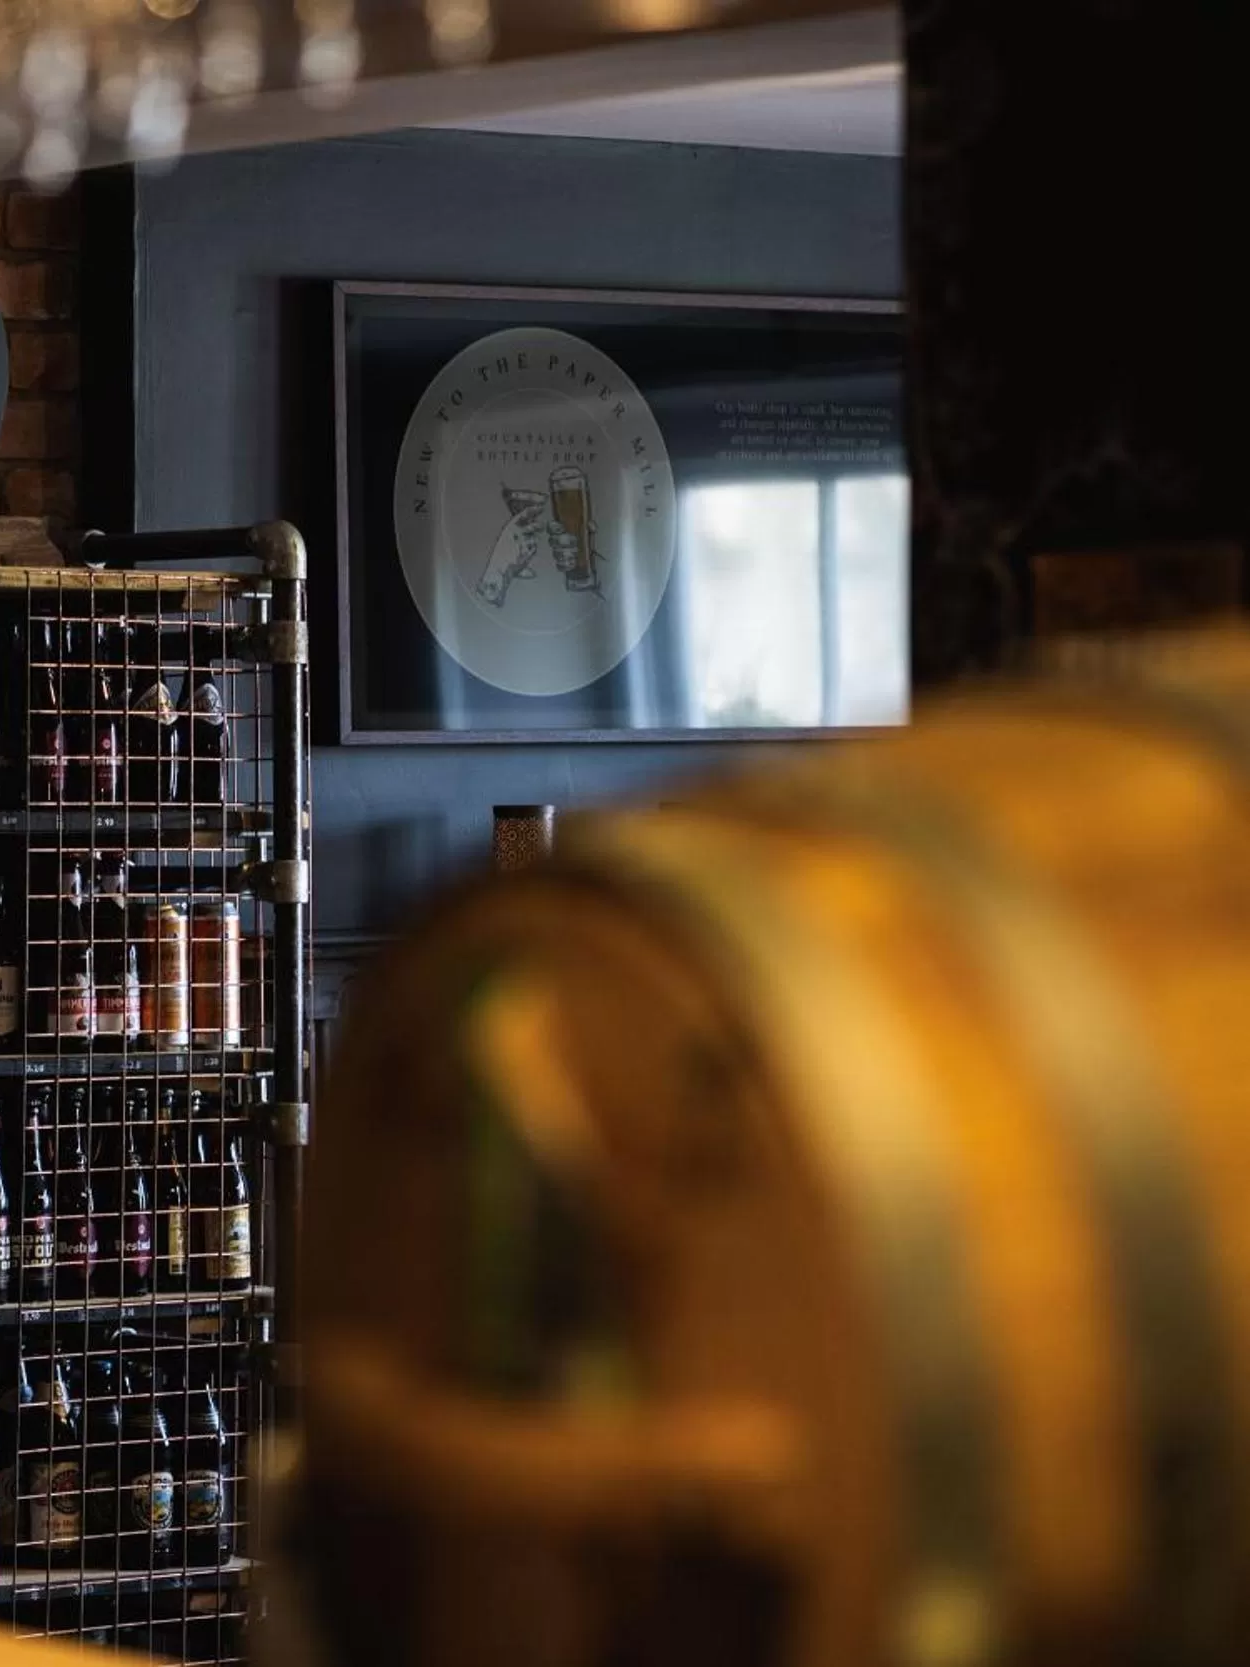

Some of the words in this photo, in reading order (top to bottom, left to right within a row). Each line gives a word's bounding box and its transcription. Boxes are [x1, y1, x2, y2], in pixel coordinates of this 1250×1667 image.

[414, 442, 434, 513] NEW
[436, 388, 463, 422] TO
[476, 352, 529, 383] THE
[547, 355, 627, 419] PAPER
[631, 436, 657, 518] MILL
